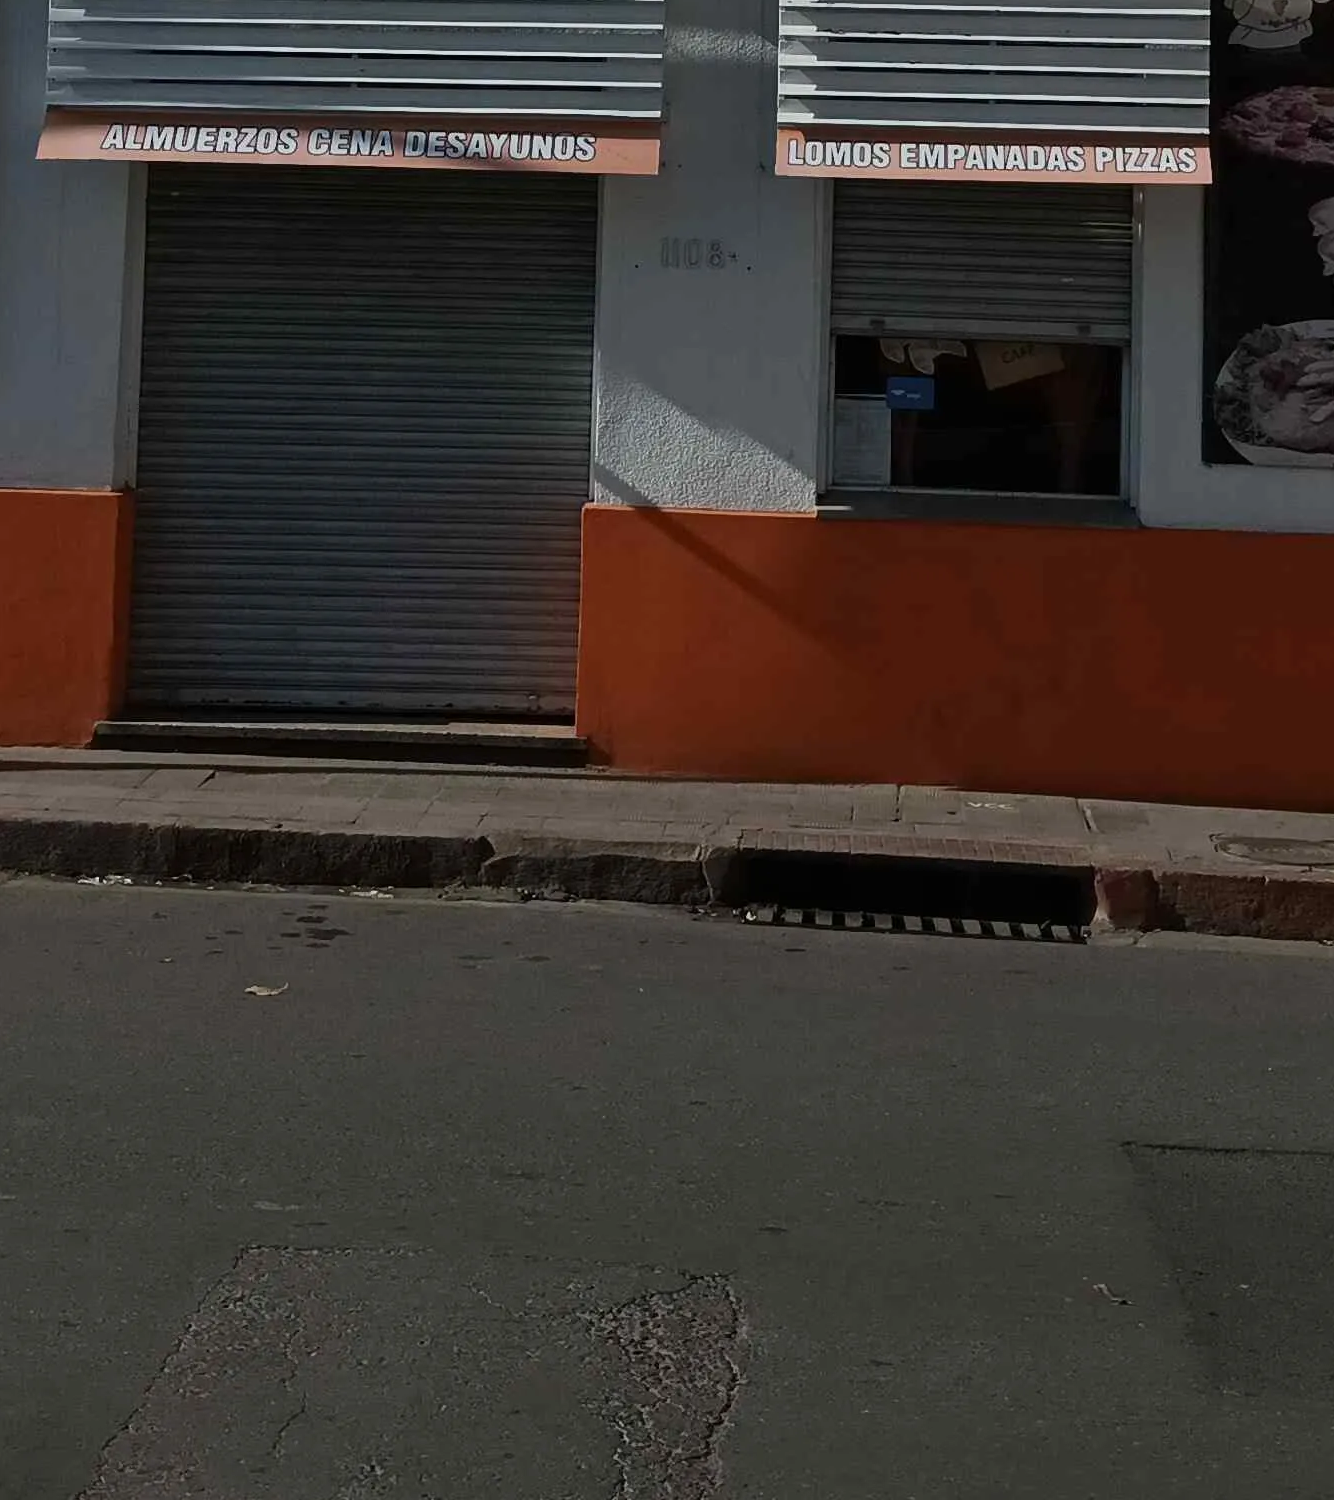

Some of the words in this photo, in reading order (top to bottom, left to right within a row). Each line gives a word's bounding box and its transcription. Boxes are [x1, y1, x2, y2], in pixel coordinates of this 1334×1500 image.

[101, 123, 298, 156] ALMUERZOS
[307, 128, 394, 158] CENA
[403, 130, 597, 161] DESAYUNOS
[787, 139, 890, 168] LOMOS
[899, 142, 1085, 172] EMPANADAS
[1094, 146, 1198, 174] PIZZAS
